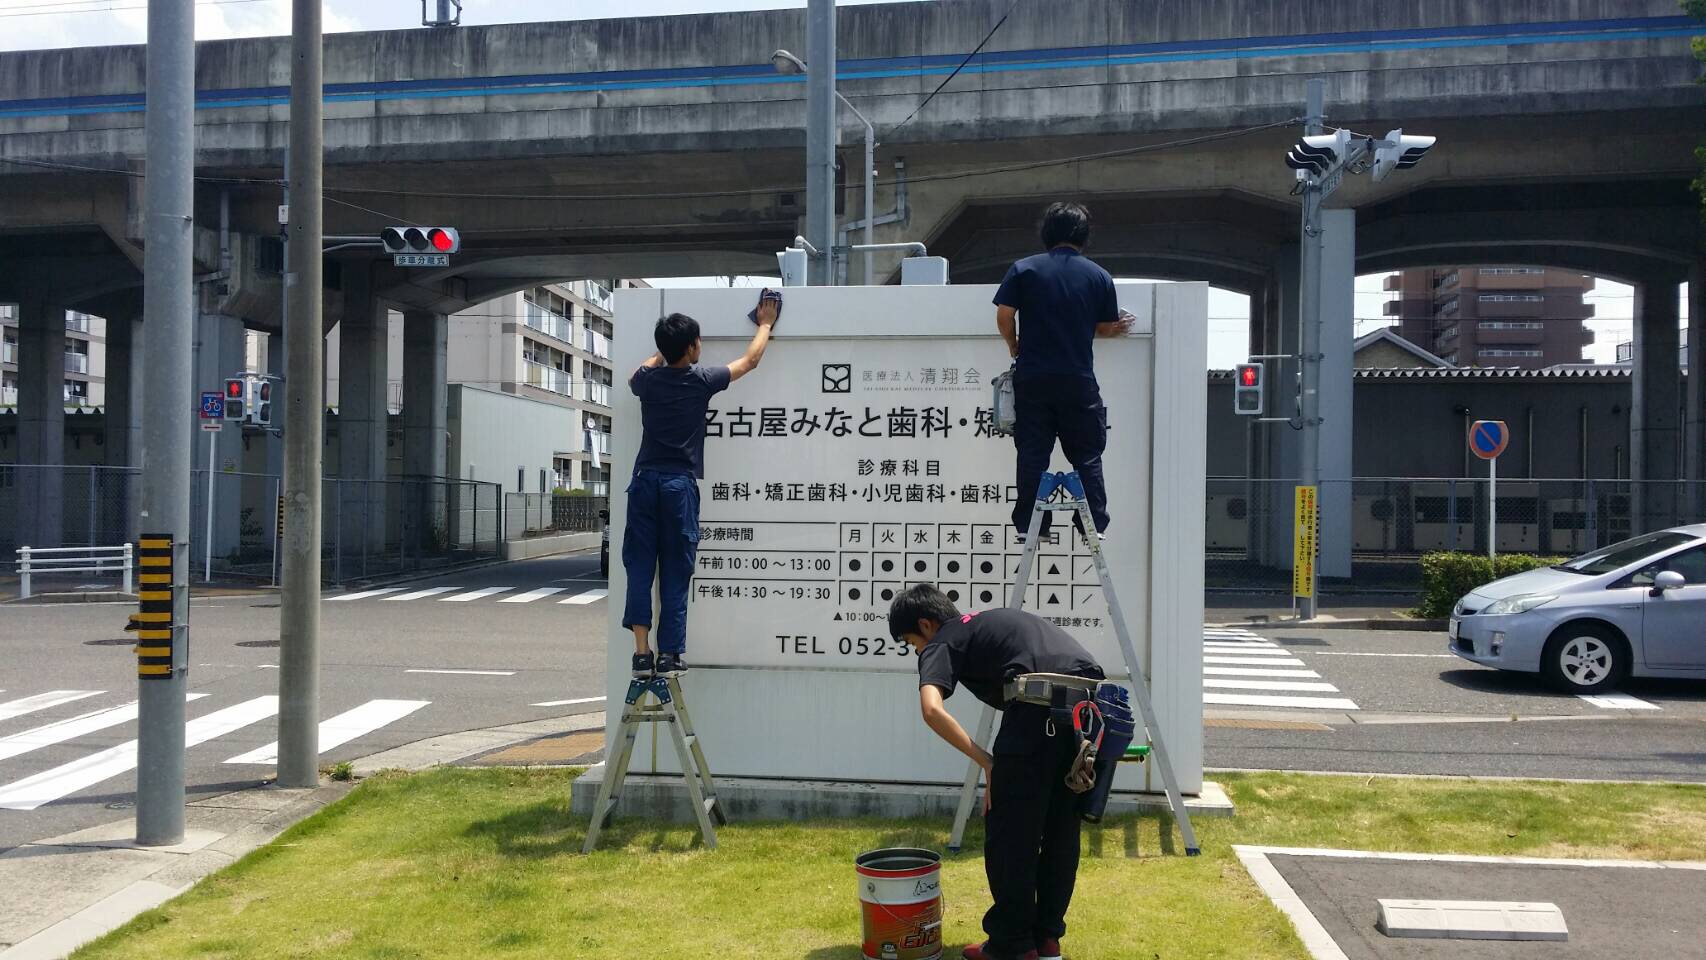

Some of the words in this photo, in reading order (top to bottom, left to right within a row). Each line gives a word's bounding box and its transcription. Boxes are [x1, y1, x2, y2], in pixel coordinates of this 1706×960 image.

[858, 459, 940, 477] 診療科目
[699, 527, 753, 541] 診療時間
[848, 529, 861, 544] 月
[881, 529, 895, 544] 火
[914, 530, 928, 544] 水
[947, 530, 961, 544] 木
[980, 530, 994, 545] 金
[775, 635, 826, 654] TEL
[838, 636, 920, 656] 052-3
